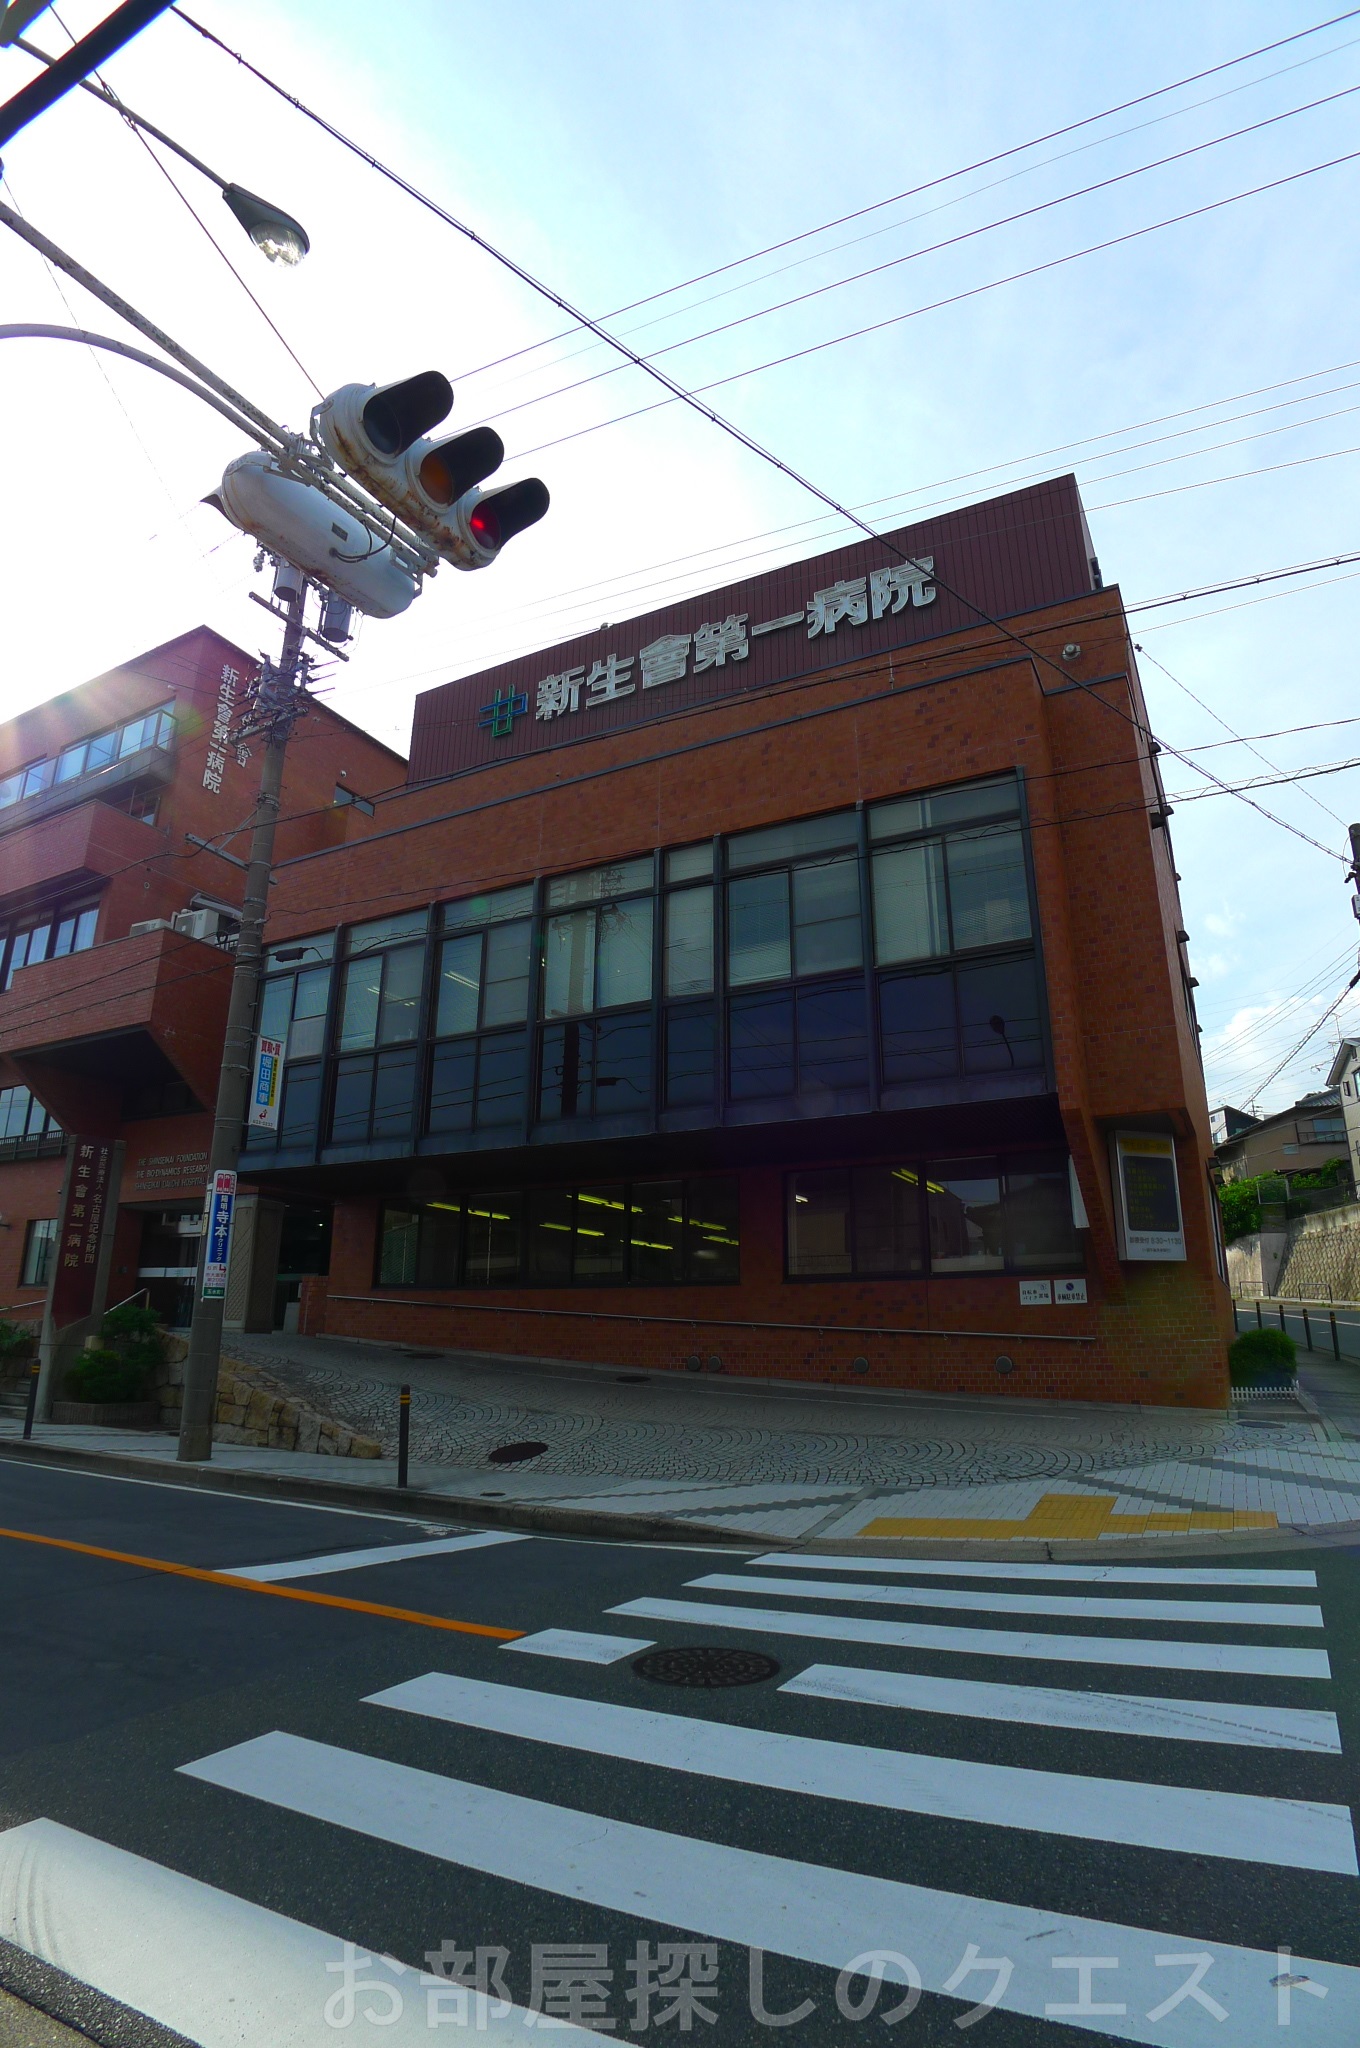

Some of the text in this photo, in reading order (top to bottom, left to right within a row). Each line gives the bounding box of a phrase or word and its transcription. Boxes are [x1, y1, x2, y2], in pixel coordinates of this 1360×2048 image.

[534, 555, 937, 722] 新生會第一病院
[257, 1056, 273, 1104] 堀田商事
[176, 1151, 209, 1163] FOUNDATION
[182, 1163, 210, 1175] RESEARCH
[181, 1176, 206, 1187] HOSPITAL
[64, 1144, 95, 1268] 新生會第一病院
[84, 1193, 103, 1264] 名古屋記念財団
